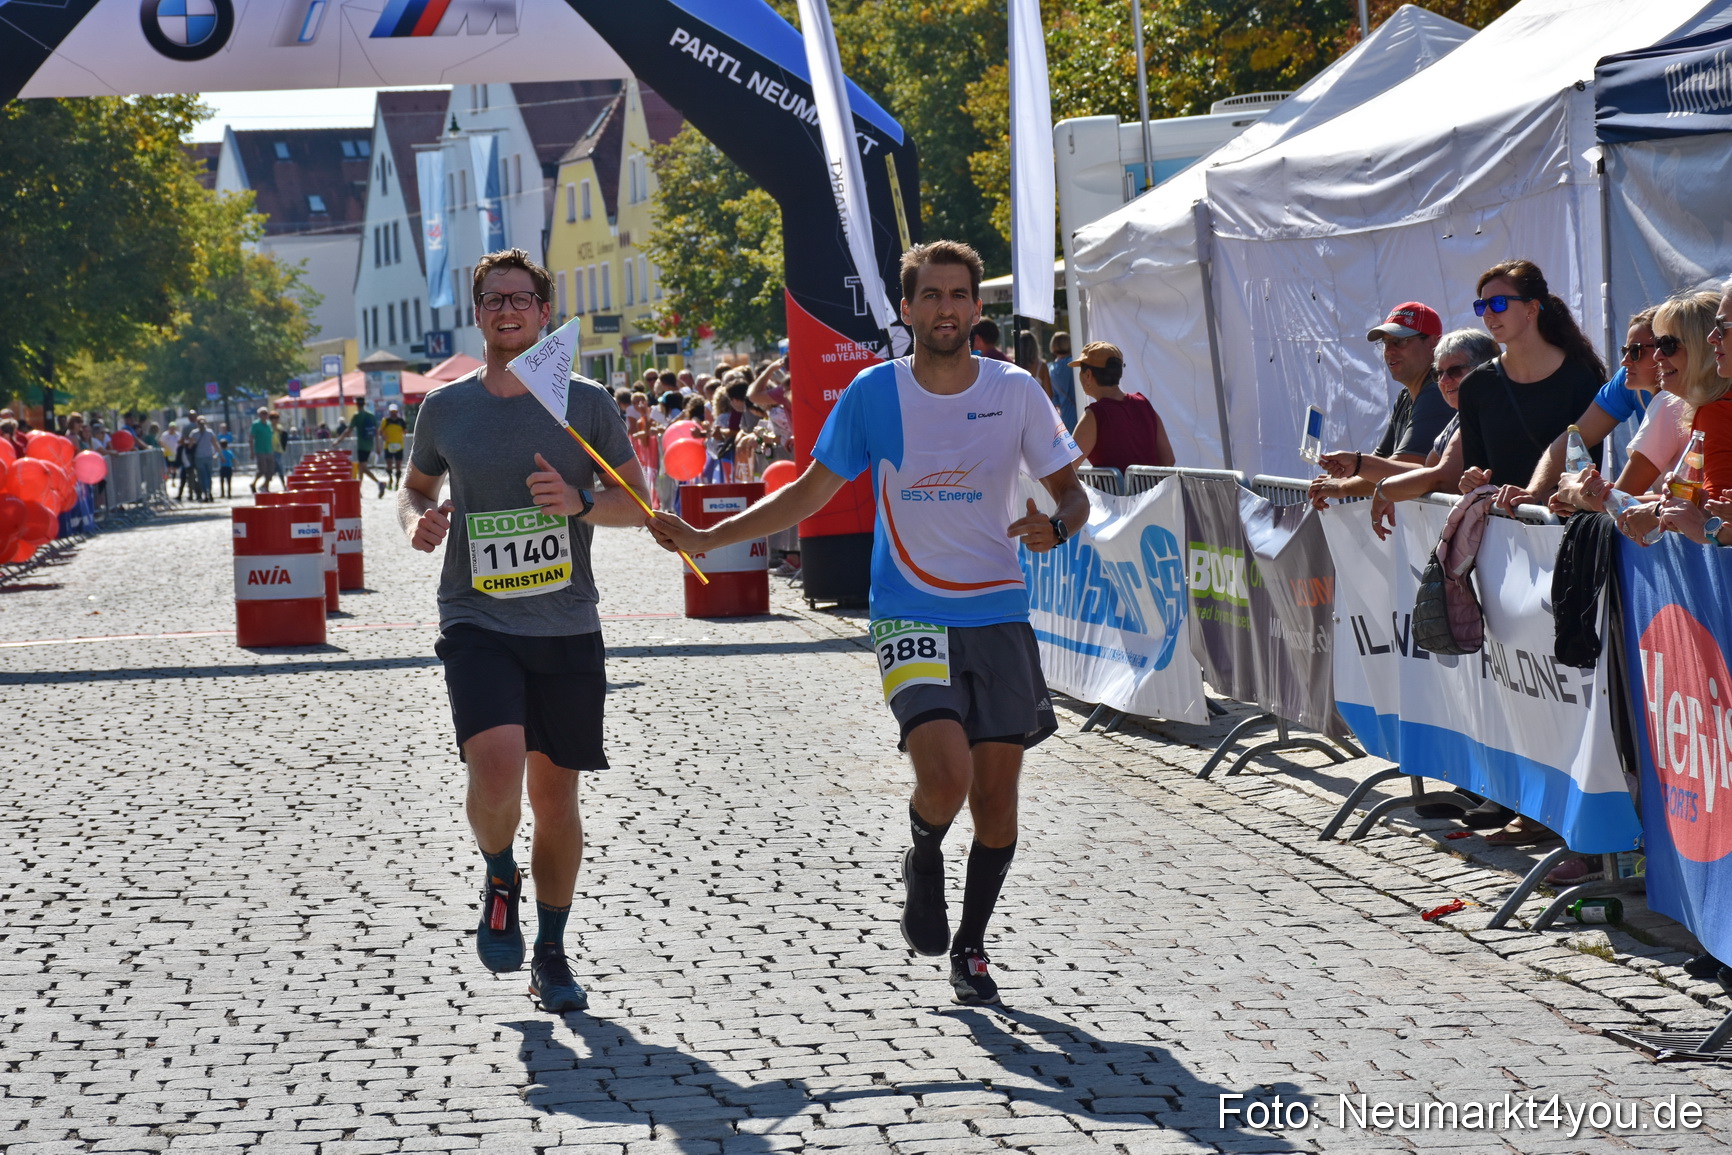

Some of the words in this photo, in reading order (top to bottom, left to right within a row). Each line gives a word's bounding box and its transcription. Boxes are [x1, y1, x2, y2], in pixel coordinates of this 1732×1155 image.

[669, 27, 742, 84] PARTL
[525, 335, 565, 373] BESTER
[821, 354, 836, 363] 100
[838, 351, 869, 361] YEARS
[835, 342, 853, 353] THE
[855, 340, 879, 351] NEXT
[551, 351, 571, 408] MANN
[823, 389, 847, 401] BM
[901, 490, 934, 501] BSX
[938, 489, 983, 503] Energie
[483, 534, 560, 570] 1140
[248, 565, 291, 585] AVIA
[483, 568, 564, 590] CHRISTIAN
[1190, 548, 1249, 599] BOCK
[881, 636, 937, 671] 388
